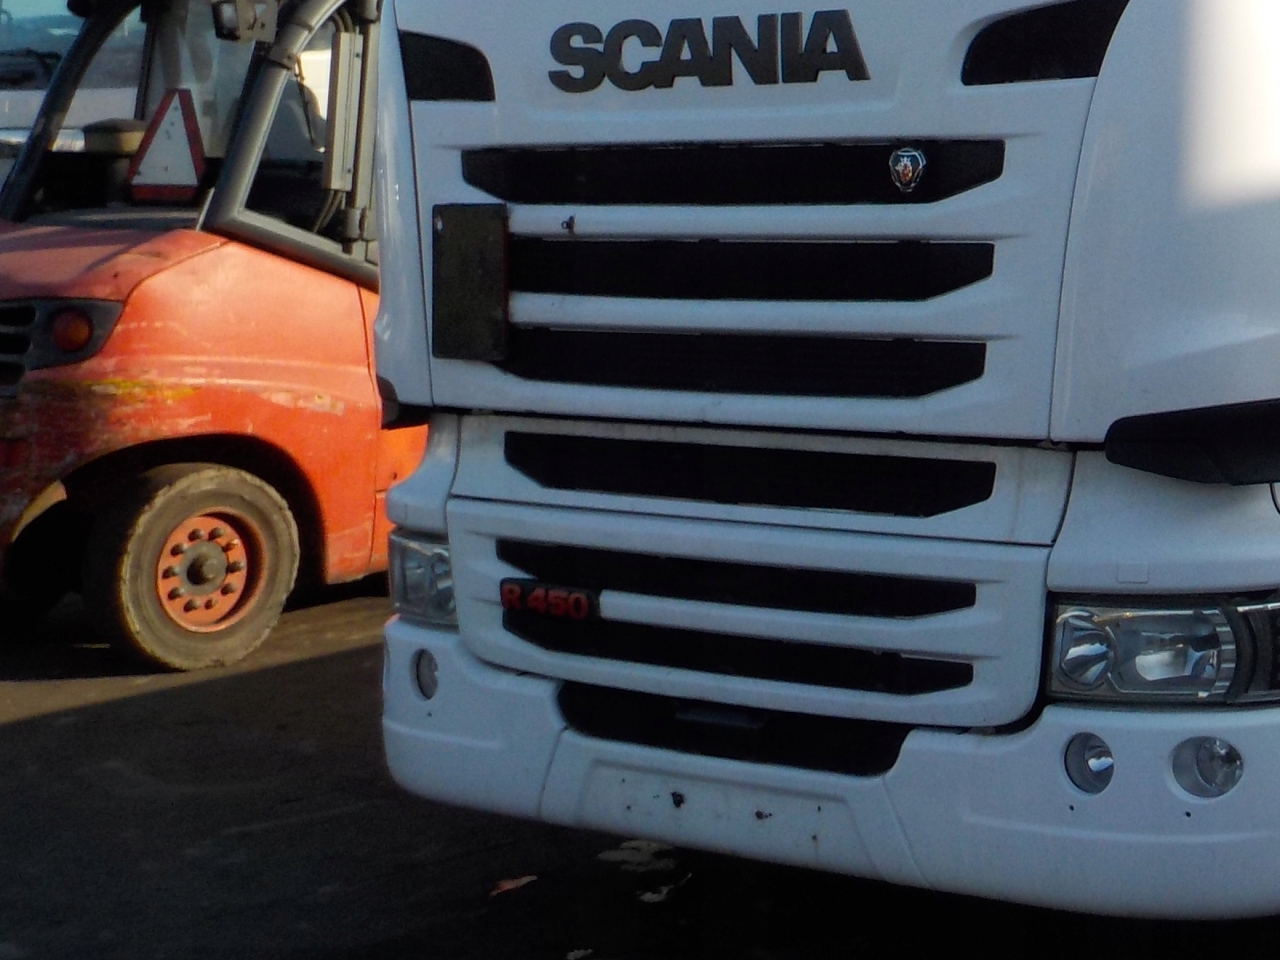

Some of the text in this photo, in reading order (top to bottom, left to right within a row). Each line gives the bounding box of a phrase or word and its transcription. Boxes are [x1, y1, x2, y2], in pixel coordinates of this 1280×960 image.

[548, 8, 871, 94] SCANIA
[501, 583, 589, 621] R 450
